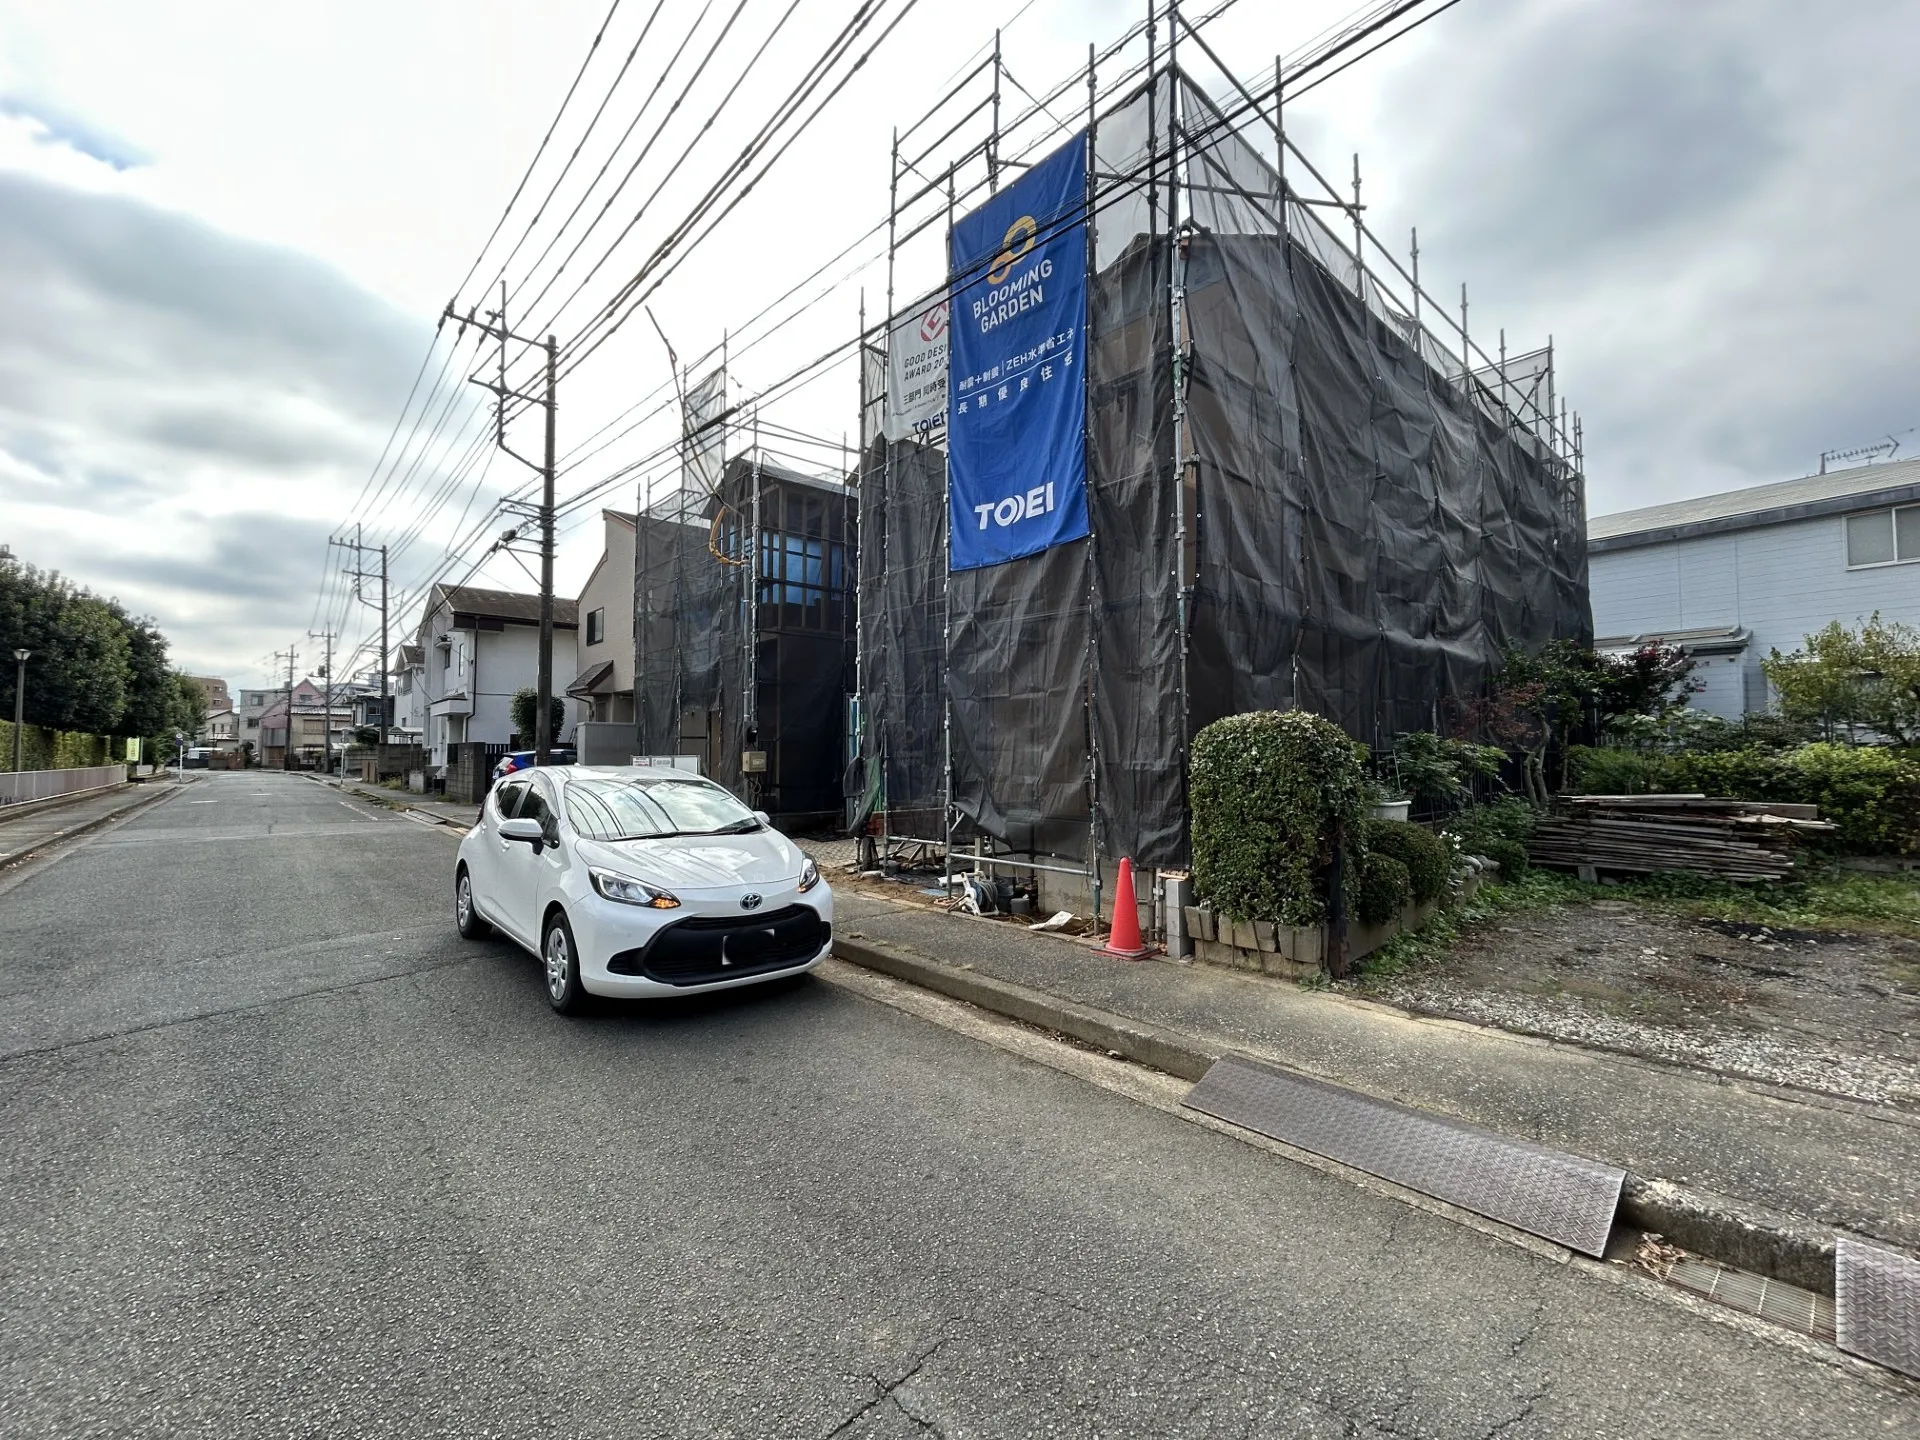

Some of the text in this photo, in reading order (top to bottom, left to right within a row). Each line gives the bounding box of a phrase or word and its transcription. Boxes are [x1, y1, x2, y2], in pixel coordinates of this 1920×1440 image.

[973, 259, 1053, 319] BLOOMING
[981, 284, 1044, 333] GARDEN
[904, 352, 926, 368] GOOD
[904, 363, 932, 381] AWARD
